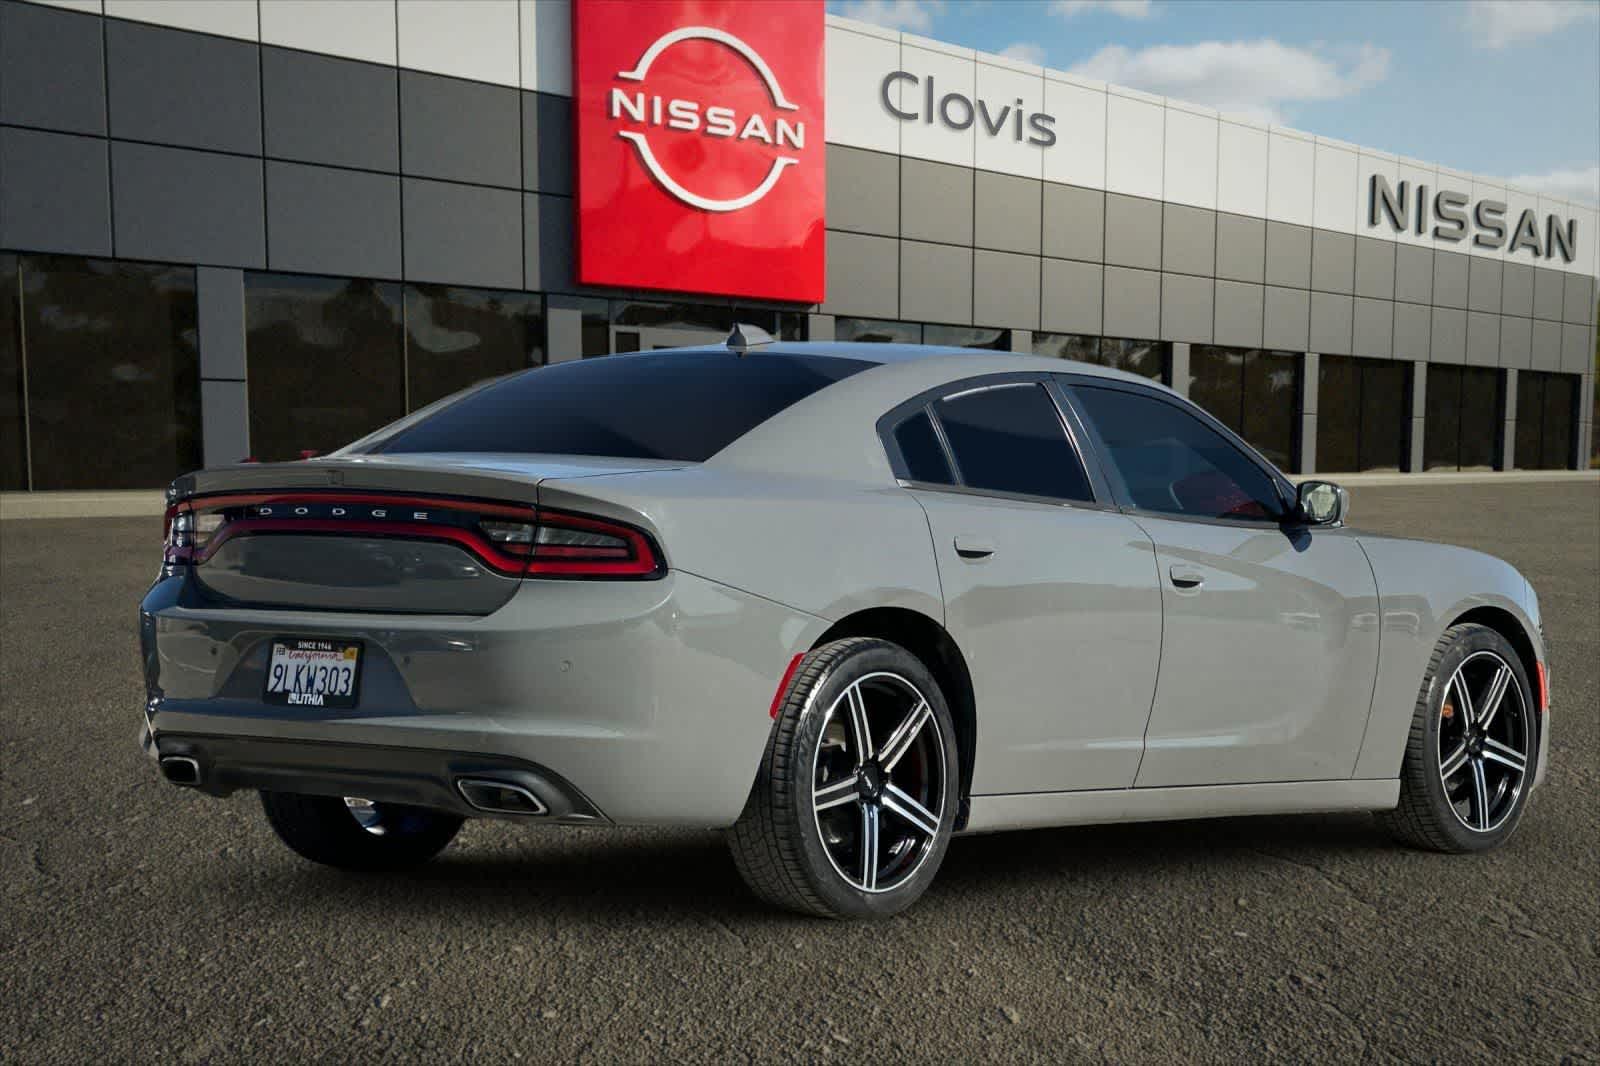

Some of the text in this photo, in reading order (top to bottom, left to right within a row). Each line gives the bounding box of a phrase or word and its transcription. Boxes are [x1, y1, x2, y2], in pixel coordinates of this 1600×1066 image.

[609, 86, 806, 149] NISSAN
[880, 70, 1058, 147] Clovis
[1368, 173, 1578, 264] NISSAN
[259, 507, 429, 520] DODGE
[298, 640, 316, 650] SINCE
[272, 664, 351, 695] 9LKW303
